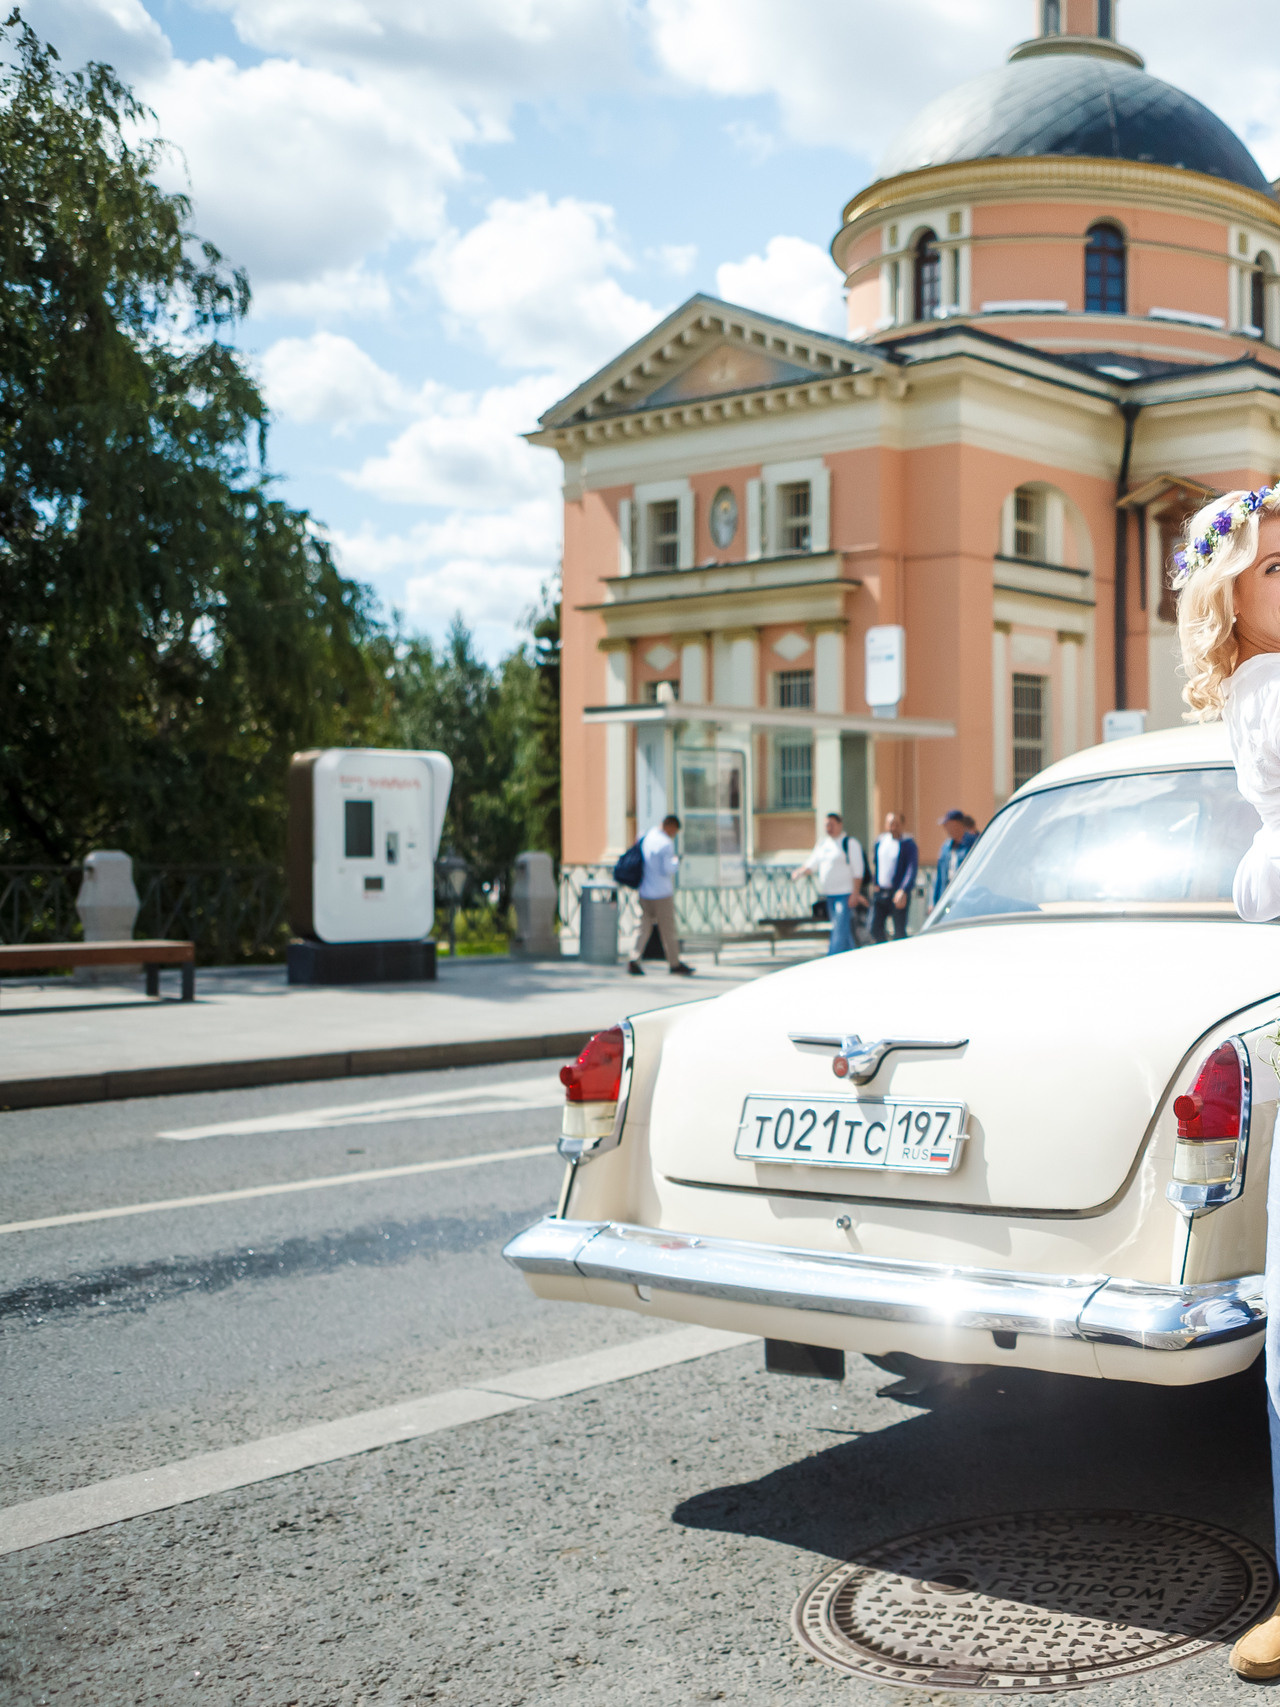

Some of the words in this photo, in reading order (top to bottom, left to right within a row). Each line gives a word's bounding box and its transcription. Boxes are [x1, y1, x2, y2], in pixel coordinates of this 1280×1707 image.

[897, 1110, 951, 1147] 197
[902, 1147, 929, 1160] RUS
[986, 1578, 1166, 1601] ГЕОПРОМ
